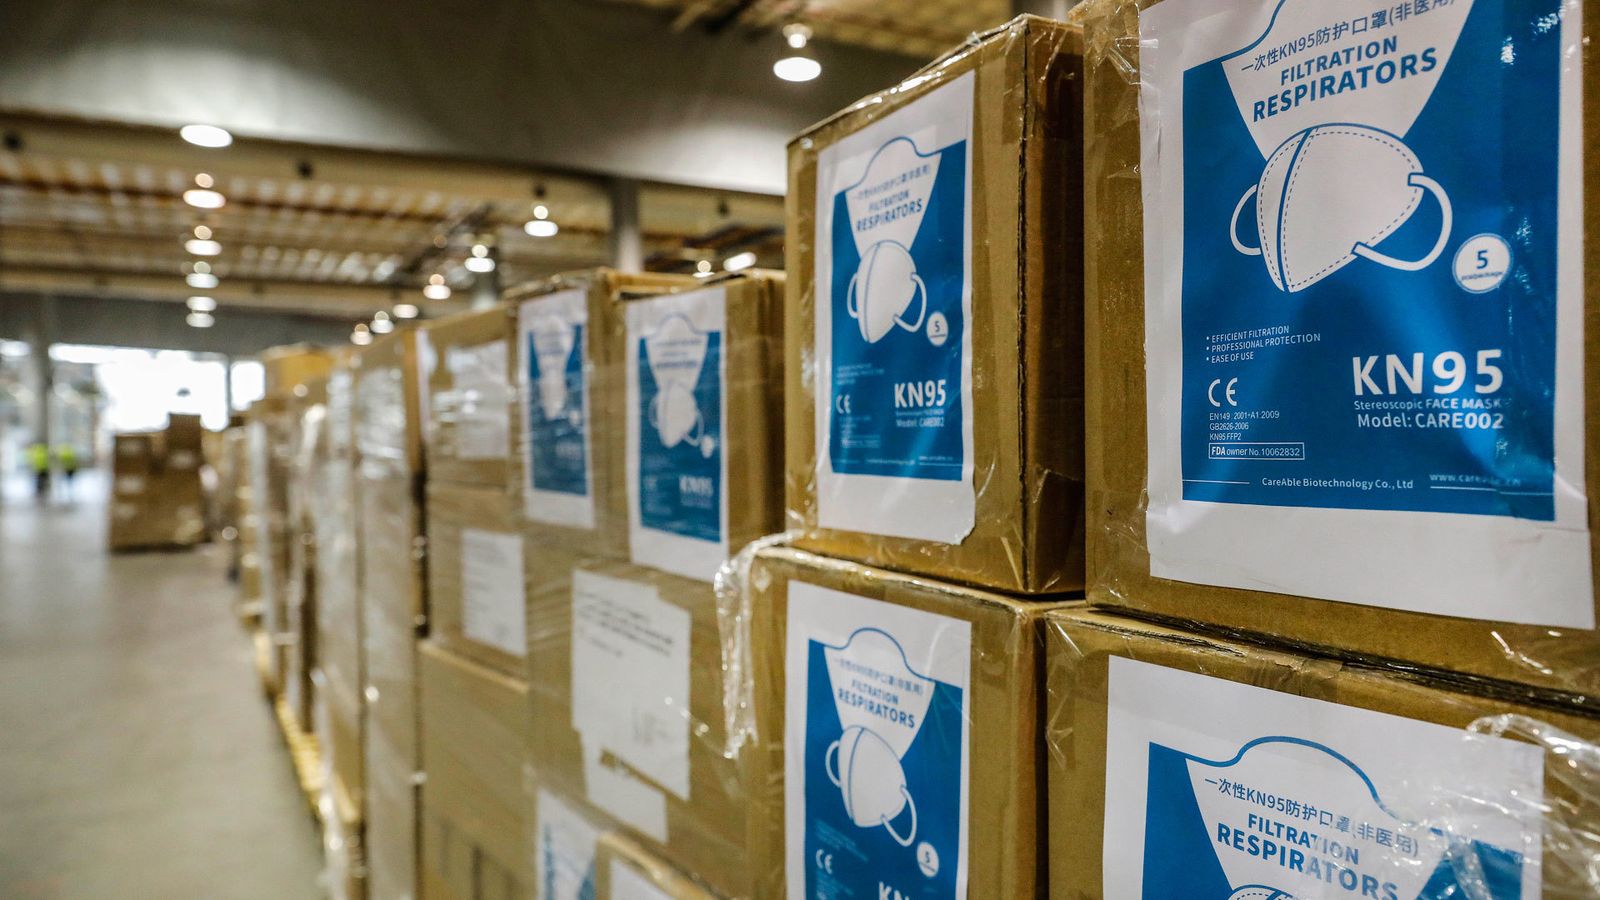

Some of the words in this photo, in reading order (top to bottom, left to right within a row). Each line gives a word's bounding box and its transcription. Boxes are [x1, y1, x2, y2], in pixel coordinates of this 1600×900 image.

[1281, 35, 1398, 85] FILTRATION
[1253, 47, 1438, 122] RESPIRATORS
[857, 198, 922, 232] RESPIRATORS
[1476, 249, 1488, 270] 5
[1211, 331, 1247, 343] EFFICIENT
[1248, 325, 1290, 338] FILTRATION
[1211, 338, 1264, 353] PROFESSIONAL
[1264, 333, 1321, 347] PROTECTION
[1211, 354, 1229, 364] EASE
[1230, 353, 1240, 362] OF
[1240, 351, 1254, 361] USE
[1352, 349, 1504, 396] KN95
[894, 379, 946, 408] KN95
[1354, 400, 1423, 412] Stereoscopic
[1425, 398, 1459, 410] FACE
[1461, 397, 1501, 409] MASK
[1209, 422, 1249, 431] GB2626-2006
[1357, 412, 1412, 428] Model:
[1415, 412, 1504, 429] CARE002
[1226, 432, 1242, 440] FFP2
[1211, 446, 1226, 456] FDA
[1226, 448, 1248, 456] owner
[1261, 477, 1301, 487] CareAble
[1302, 478, 1374, 490] Biotechnology
[1396, 480, 1414, 489] Ltd
[838, 687, 915, 728] RESPIRATORS
[1248, 813, 1359, 866] FILTRATION
[1217, 823, 1398, 900] RESPIRATORS
